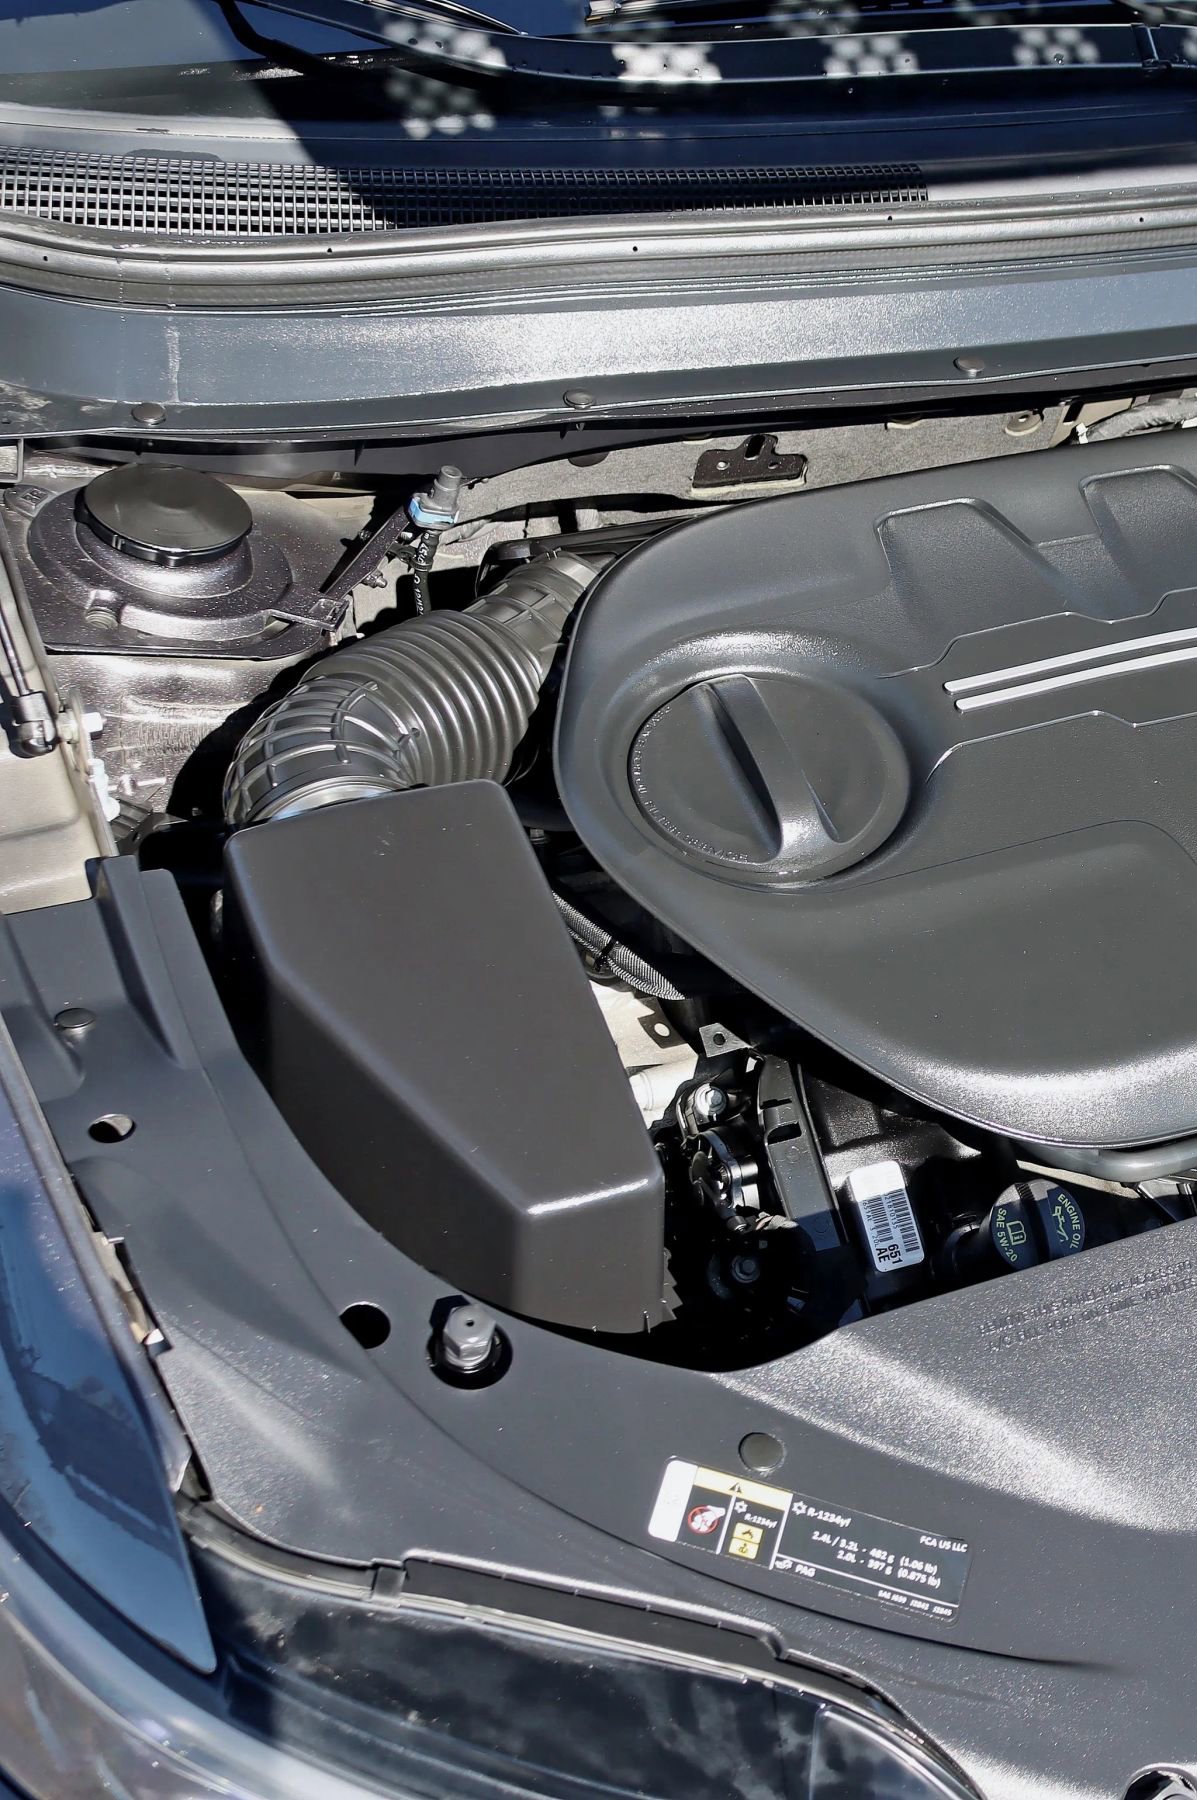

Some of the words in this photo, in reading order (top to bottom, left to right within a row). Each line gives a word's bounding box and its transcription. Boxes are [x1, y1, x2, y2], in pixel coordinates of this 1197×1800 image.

[996, 1207, 1007, 1229] SAE
[1057, 1193, 1081, 1231] ENGINE
[1069, 1232, 1081, 1249] OIL
[876, 1247, 891, 1263] AE
[888, 1243, 903, 1264] 651
[997, 1231, 1018, 1262] 5W-20
[1140, 1275, 1197, 1303] VEHICLES
[807, 1507, 852, 1528] R-1234yf
[811, 1531, 832, 1544] 2.4L
[839, 1538, 859, 1552] 3.2L
[900, 1555, 924, 1571] (1.06
[924, 1563, 938, 1576] lb)
[919, 1535, 938, 1548] FCA
[938, 1542, 951, 1550] US
[951, 1543, 968, 1553] LLC
[795, 1563, 816, 1577] PAG
[836, 1550, 858, 1564] 2.0L
[897, 1567, 928, 1584] (0.875
[927, 1577, 941, 1589] lb)
